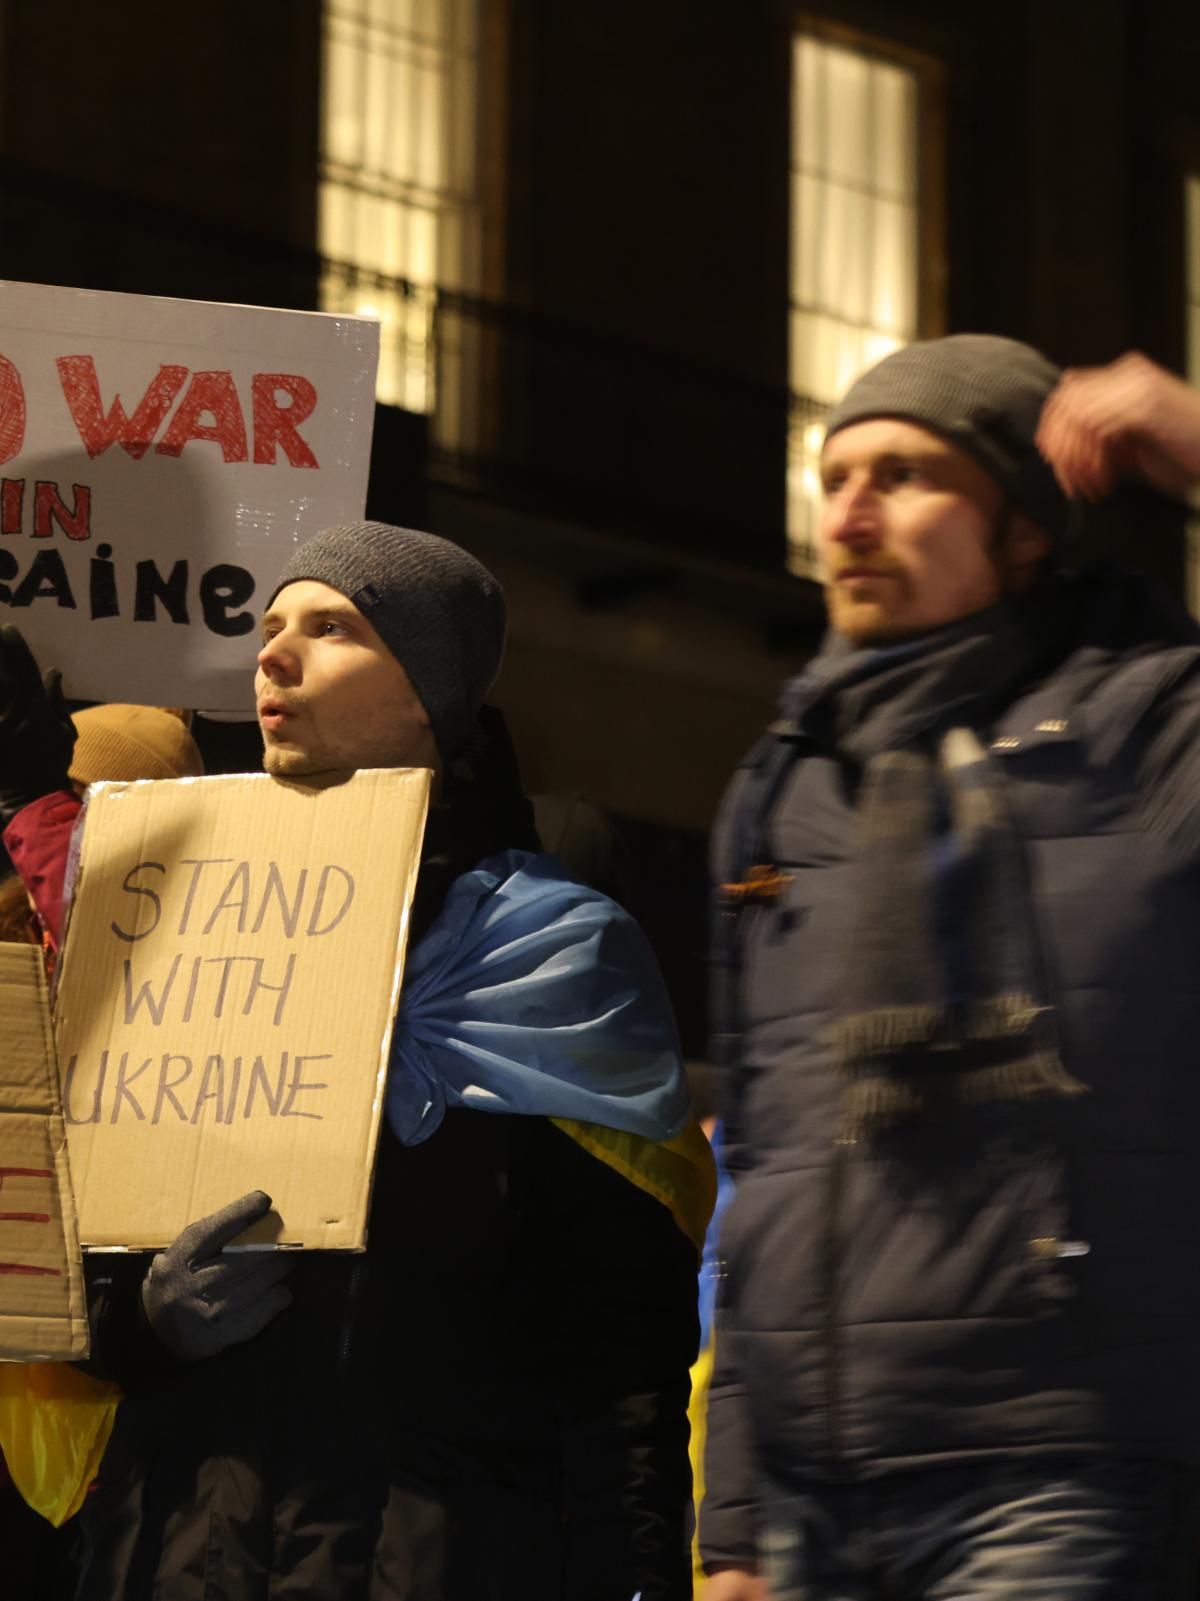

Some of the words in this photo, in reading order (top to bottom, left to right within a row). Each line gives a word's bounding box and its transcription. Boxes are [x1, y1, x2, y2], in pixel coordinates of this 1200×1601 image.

[55, 354, 321, 470] WAR
[0, 477, 92, 541] IN
[111, 859, 356, 942] STAND
[122, 953, 297, 1027] WITH
[62, 1050, 334, 1126] UKRAINE
